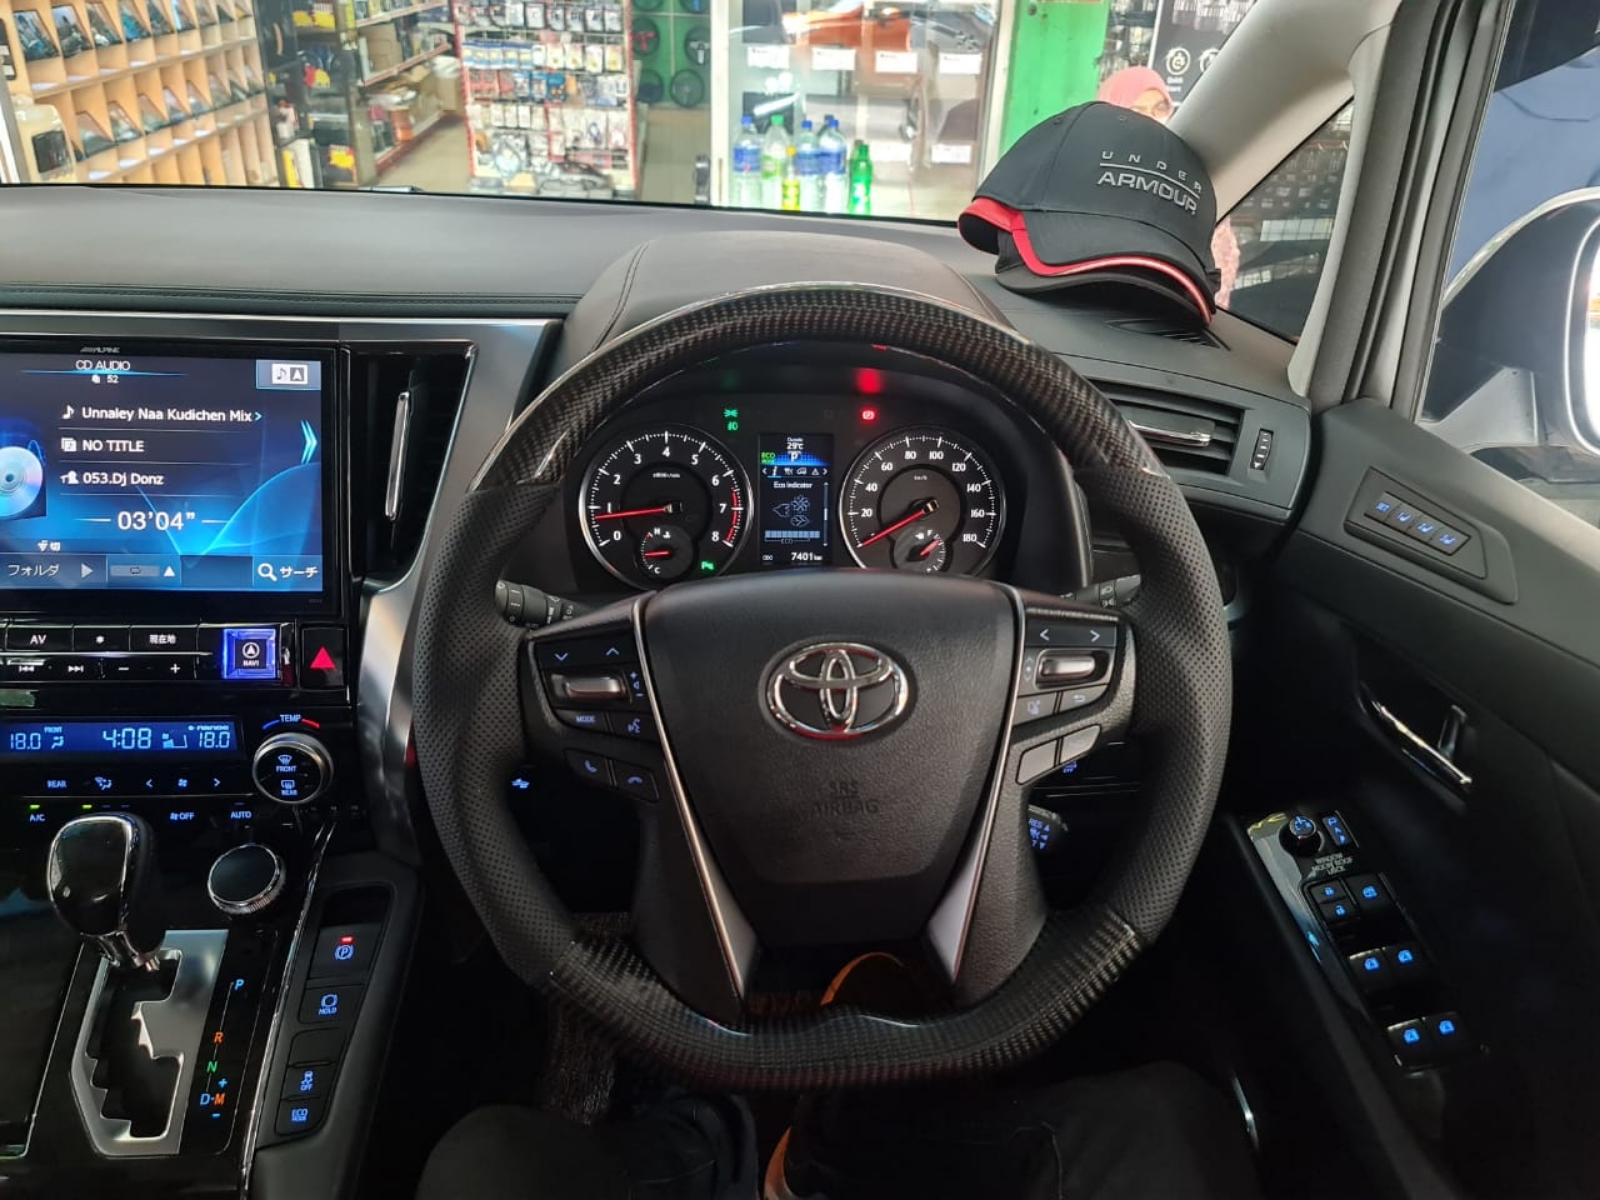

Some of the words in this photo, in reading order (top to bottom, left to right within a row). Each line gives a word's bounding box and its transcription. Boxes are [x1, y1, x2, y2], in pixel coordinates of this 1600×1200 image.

[1101, 150, 1203, 193] UNDER
[1096, 171, 1198, 215] ARMOUR
[75, 359, 93, 371] CD
[95, 360, 131, 371] AUDIO
[106, 375, 119, 384] 52
[138, 408, 163, 421] Naa
[167, 409, 225, 423] Kudichen
[229, 411, 252, 422] Mix
[82, 439, 103, 452] NO
[106, 440, 145, 453] TITLE
[663, 448, 670, 458] 4
[905, 450, 917, 460] 80
[929, 450, 944, 460] 100
[634, 455, 642, 465] 3
[691, 456, 699, 465] 5
[881, 462, 893, 472] 60
[952, 462, 966, 472] 120
[130, 474, 164, 486] Donz
[614, 475, 622, 486] 2
[713, 476, 720, 487] 6
[865, 483, 878, 493] 40
[966, 483, 981, 493] 140
[720, 504, 727, 514] 7
[861, 508, 873, 518] 20
[971, 508, 985, 518] 160
[614, 531, 622, 541] 0
[712, 532, 720, 542] 8
[963, 534, 977, 543] 180
[791, 552, 814, 561] 7401
[8, 564, 60, 577] フォルダ
[279, 566, 319, 577] サーチ
[30, 635, 46, 645] AV
[149, 634, 176, 645] 現在地
[280, 714, 301, 723] TEMP
[576, 715, 596, 723] MODE
[10, 733, 41, 750] 18.0
[102, 729, 152, 749] 4:08
[199, 732, 231, 749] 18.0
[47, 780, 67, 789] REAR
[30, 814, 46, 823] A/C
[179, 812, 195, 821] OFF
[230, 810, 252, 820] AUTO
[234, 979, 245, 990] P
[318, 1007, 337, 1015] HOLD
[214, 1031, 224, 1043] R
[206, 1061, 218, 1072] N
